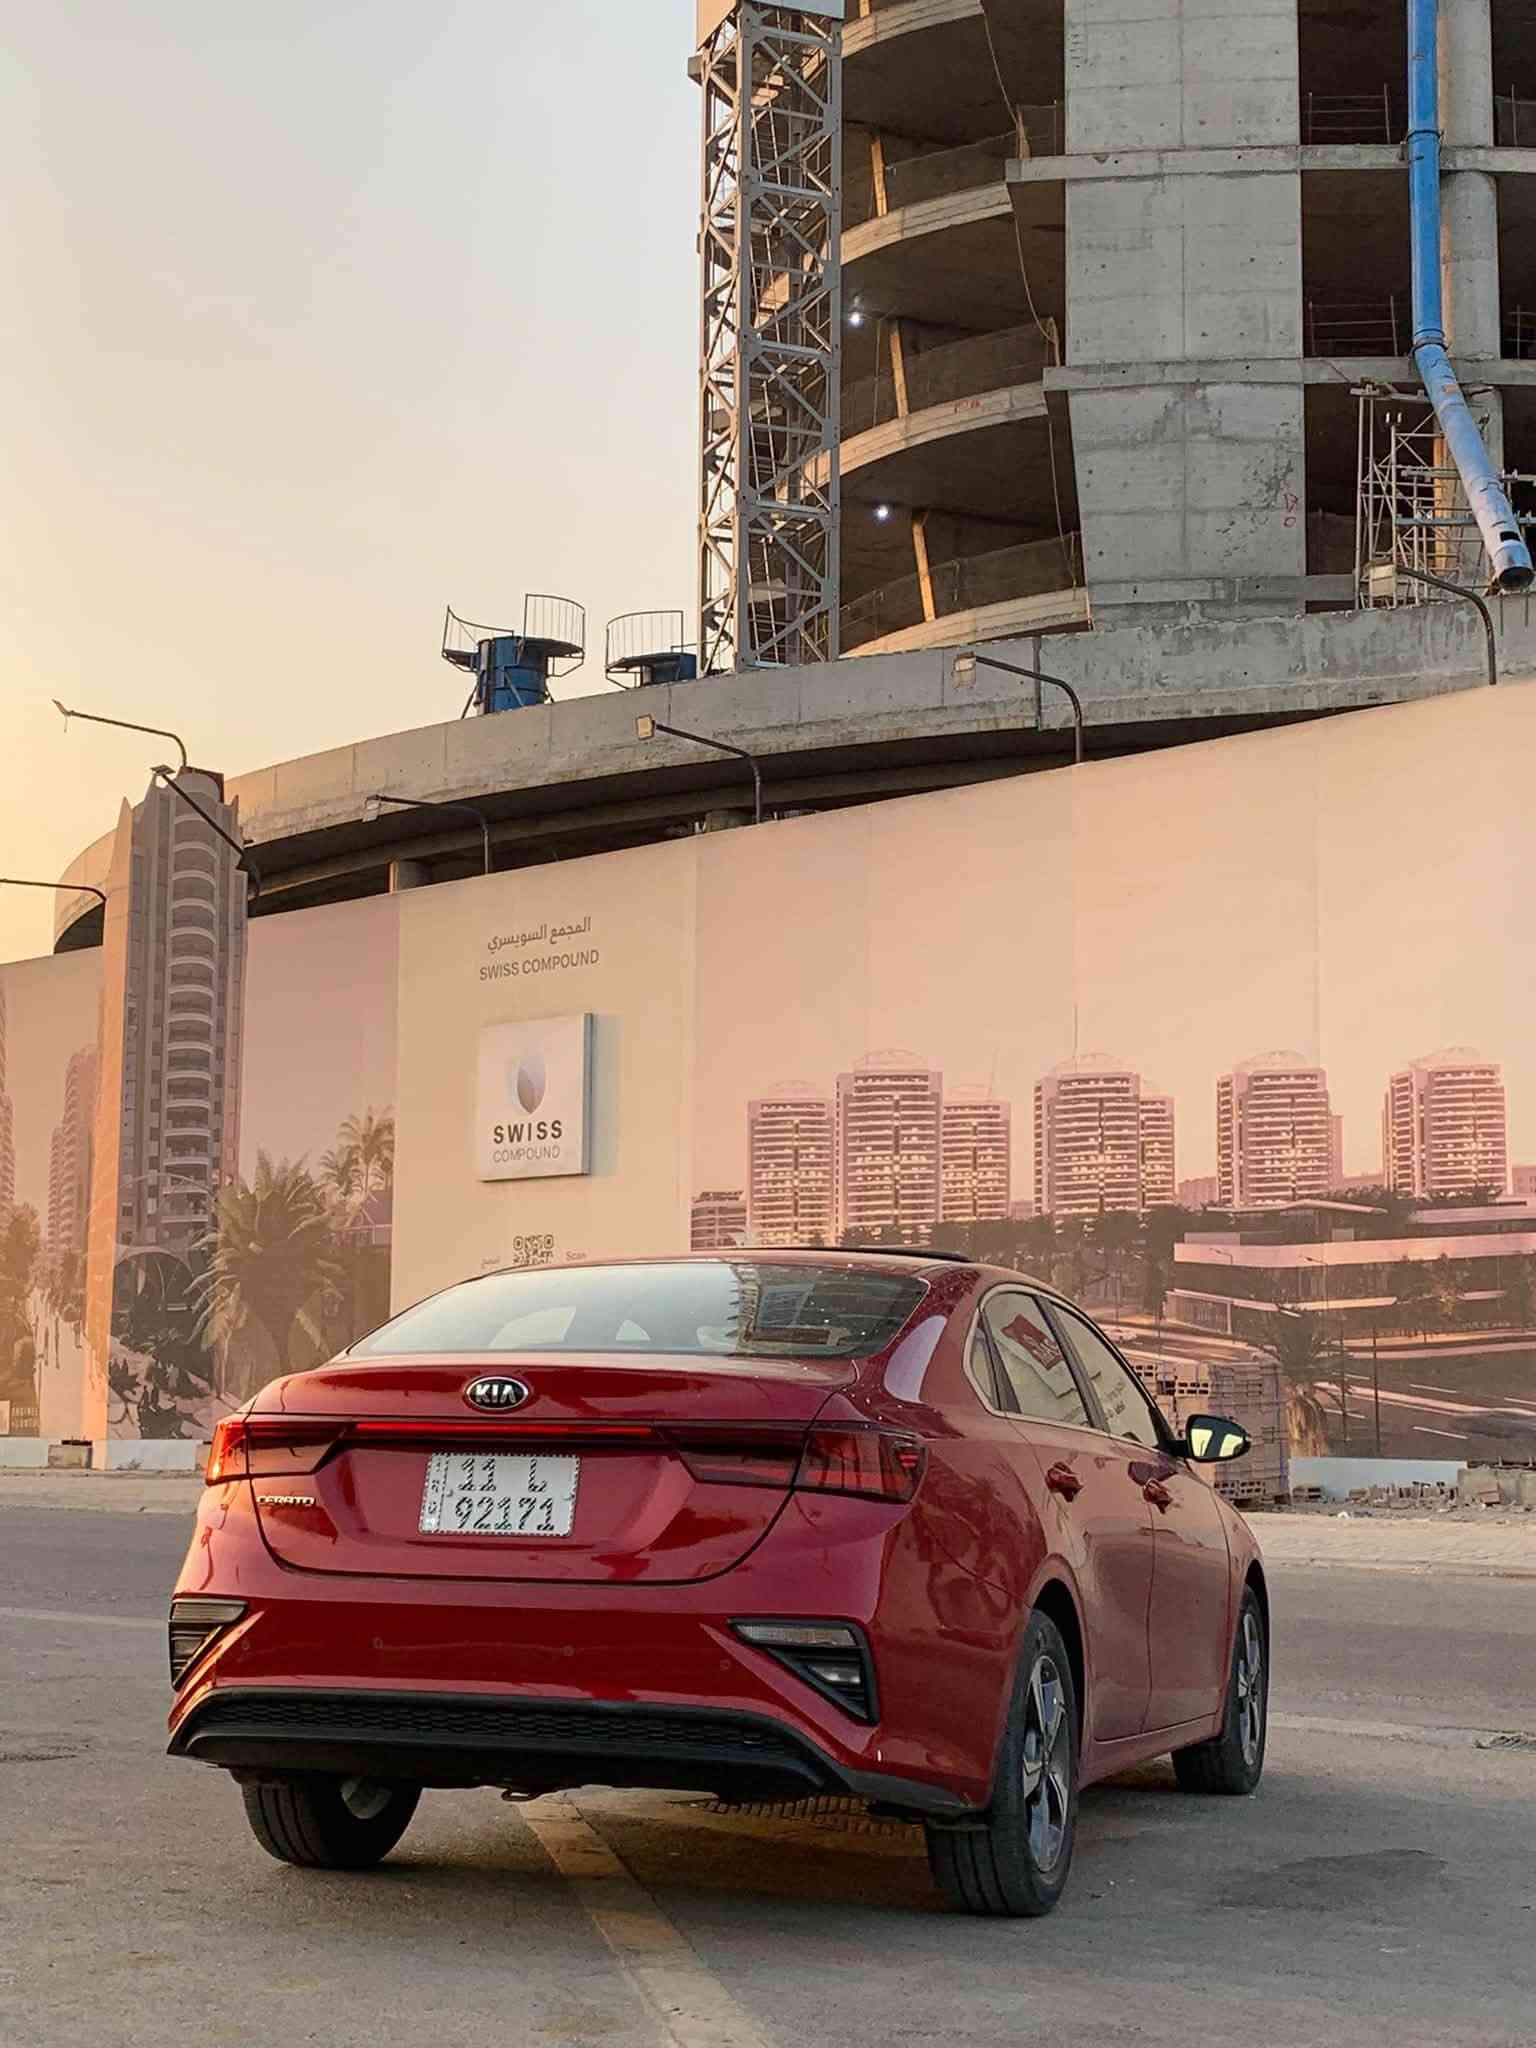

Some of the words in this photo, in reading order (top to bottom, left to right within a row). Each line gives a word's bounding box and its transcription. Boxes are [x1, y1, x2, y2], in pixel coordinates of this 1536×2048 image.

[487, 924, 547, 954] السويسري
[548, 916, 592, 945] المجمع
[480, 961, 520, 981] SWISS
[521, 949, 600, 975] COMPOUND
[493, 1120, 563, 1145] SWISS
[493, 1145, 561, 1163] COMPOUND
[475, 1383, 517, 1403] KIA
